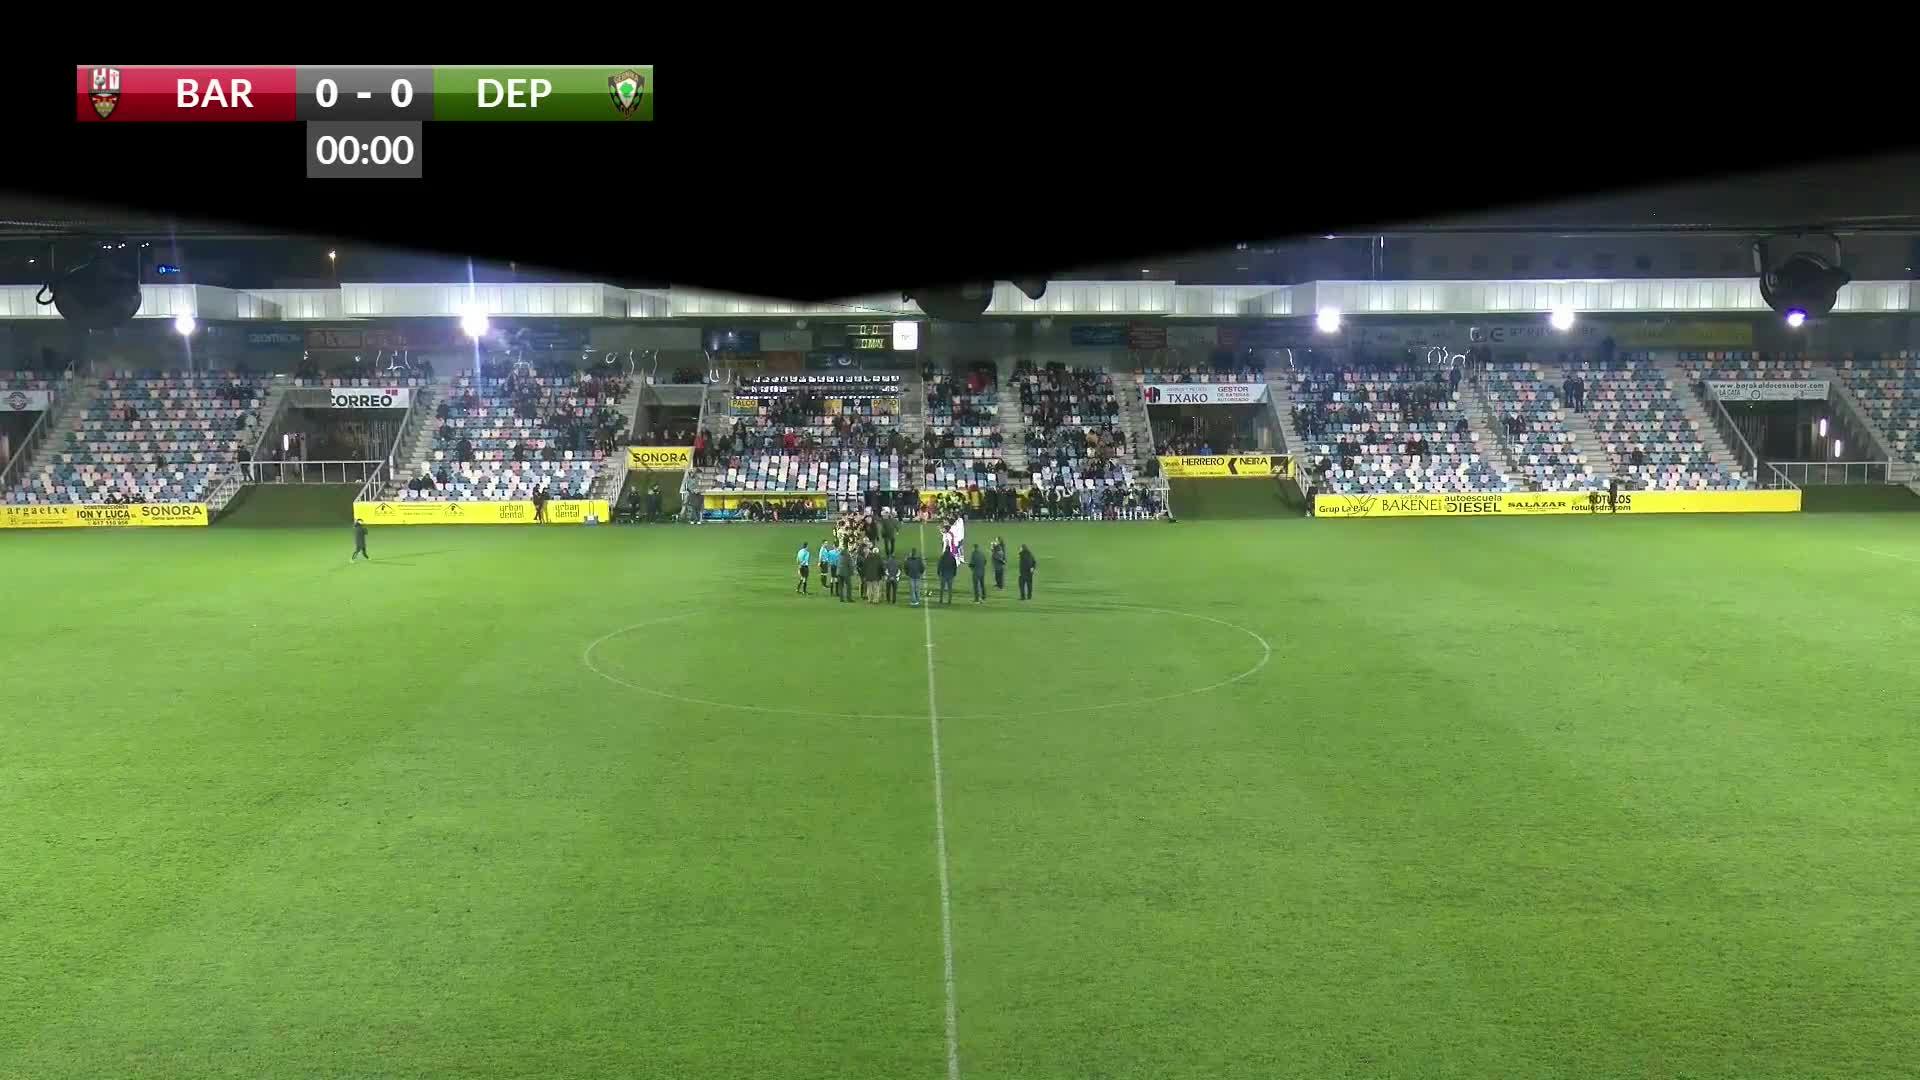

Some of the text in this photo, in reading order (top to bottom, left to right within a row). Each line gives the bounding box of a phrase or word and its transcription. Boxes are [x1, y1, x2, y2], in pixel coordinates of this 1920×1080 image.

[1167, 393, 1208, 403] TXAKO
[633, 452, 688, 463] SONORA
[1181, 457, 1225, 466] HERRERO
[1240, 457, 1268, 465] NEIRA
[1444, 494, 1502, 502] autoescuela
[141, 505, 202, 516] SONORA
[499, 503, 524, 513] urban
[555, 502, 580, 512] urban
[1319, 505, 1340, 514] Grup
[1446, 502, 1502, 512] DIESEL
[96, 510, 102, 518] Y
[105, 510, 130, 518] LUCA
[499, 510, 524, 519] dental
[555, 509, 580, 518] dental
